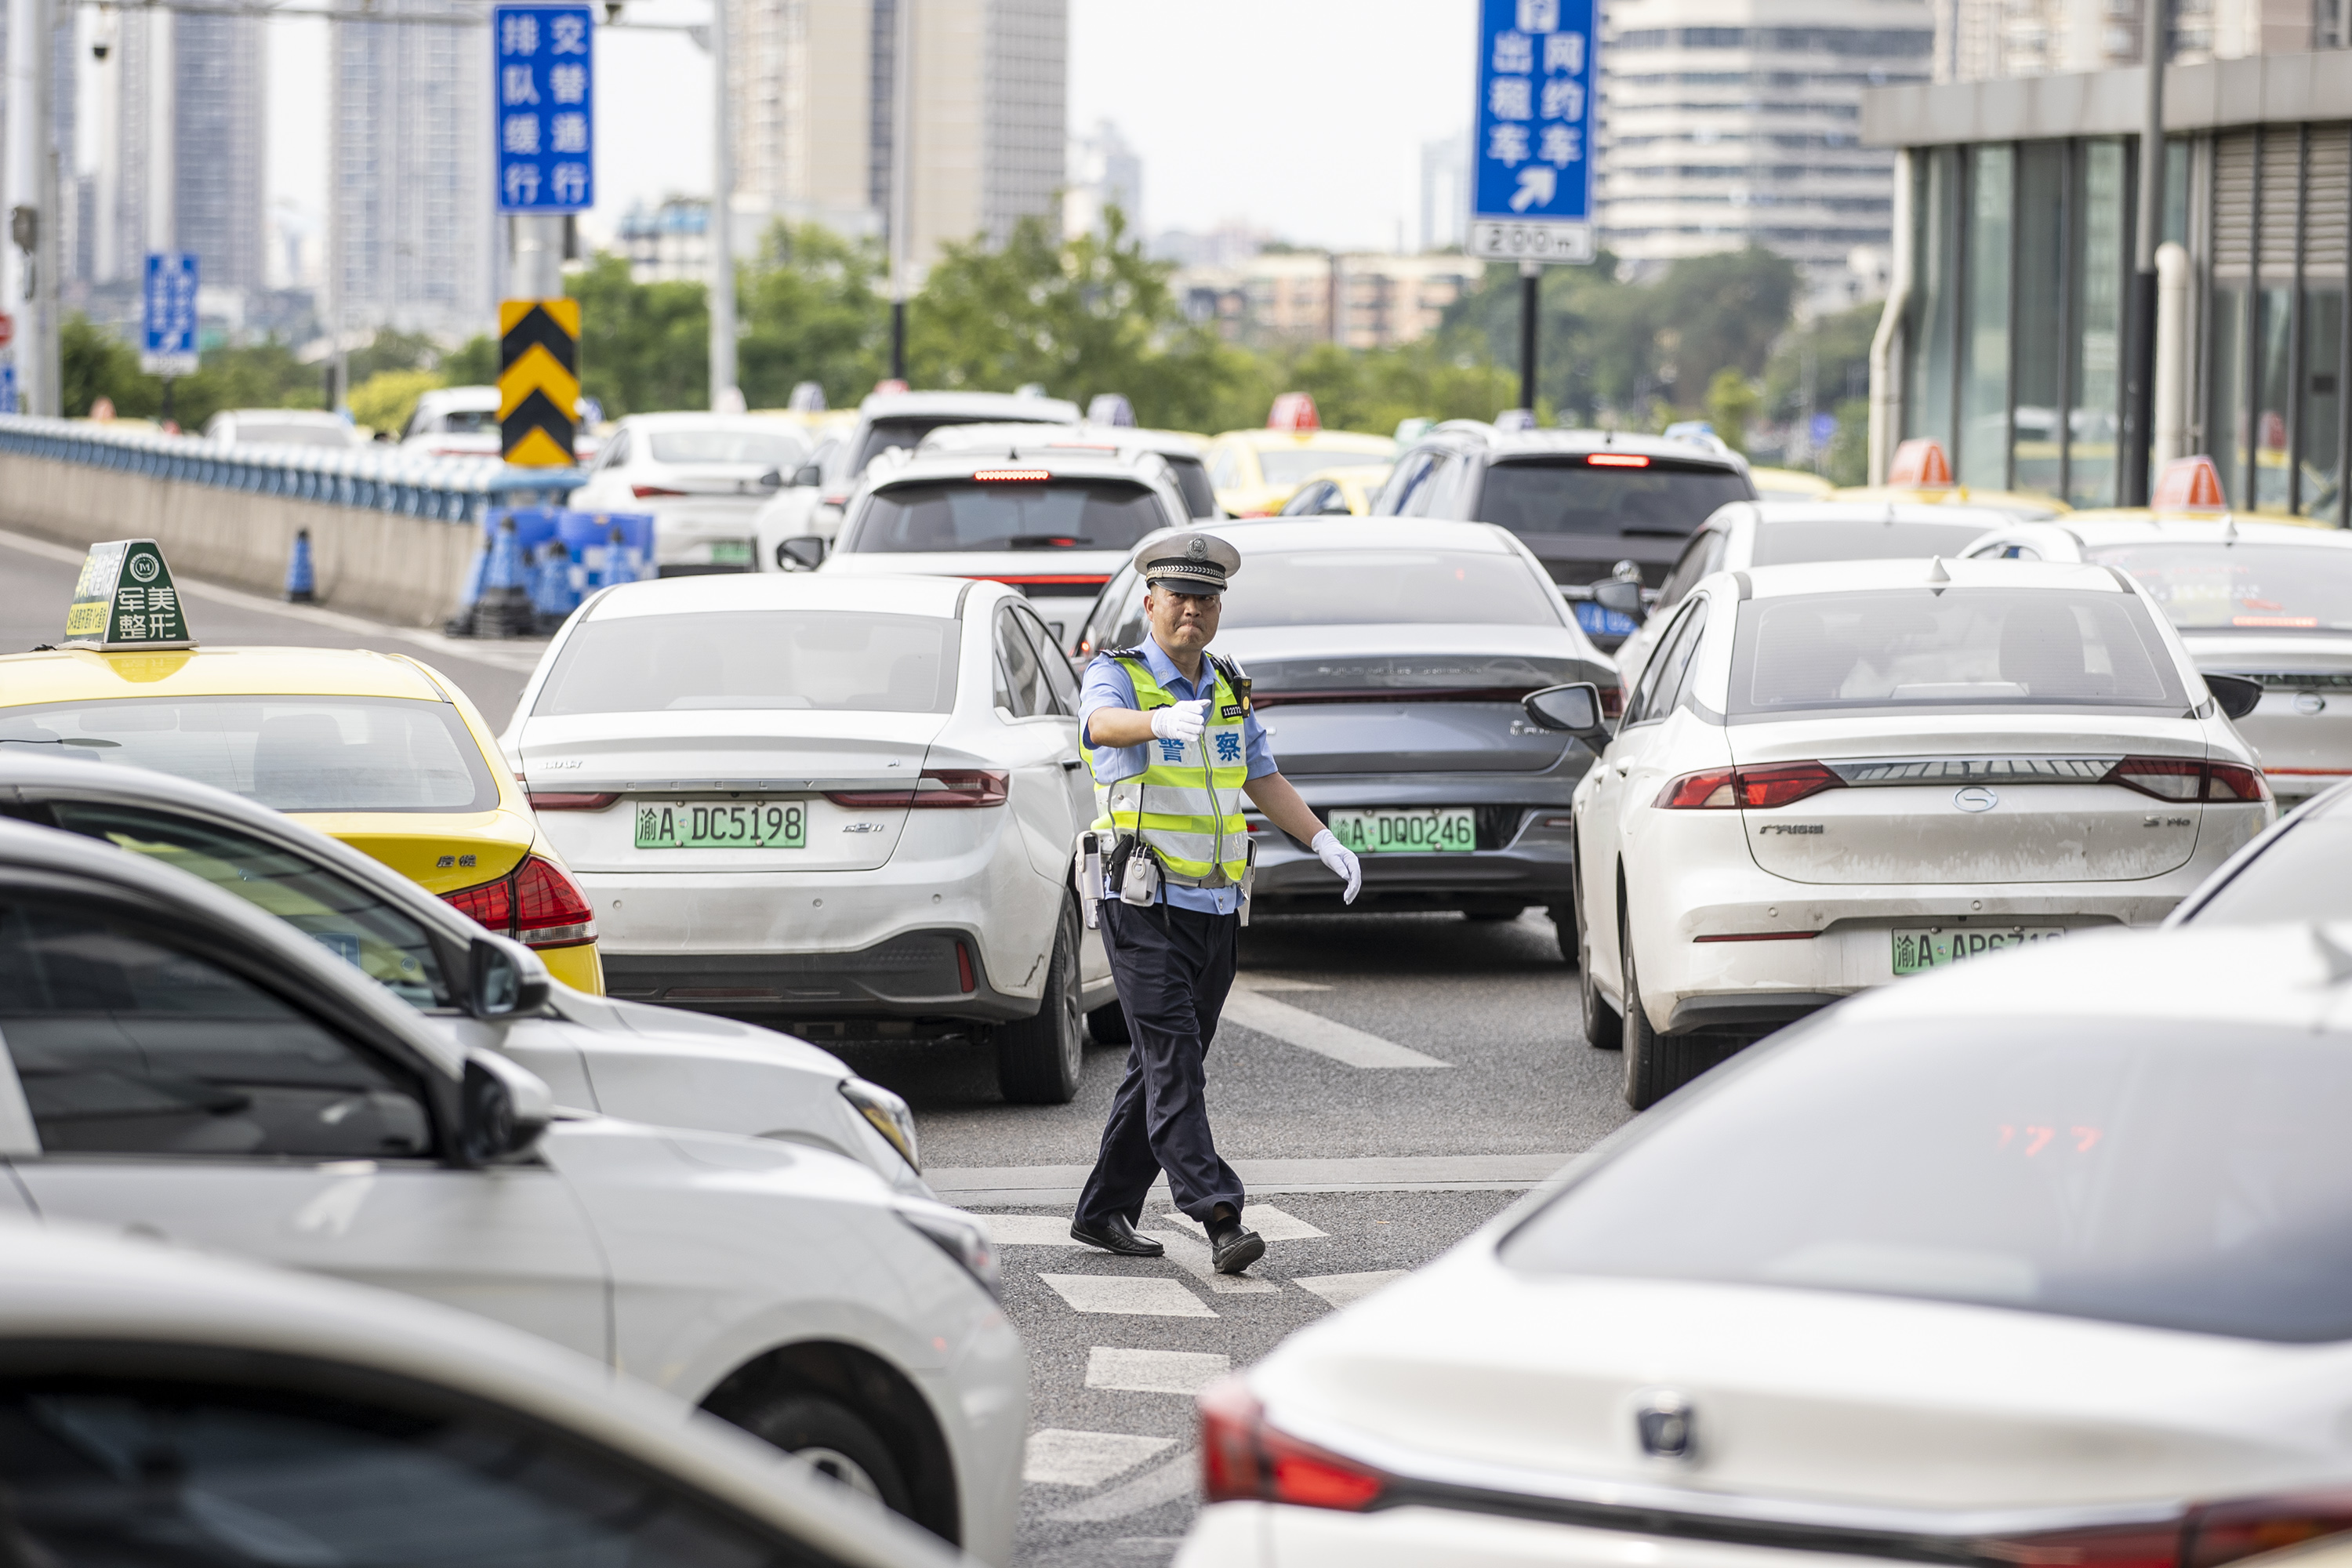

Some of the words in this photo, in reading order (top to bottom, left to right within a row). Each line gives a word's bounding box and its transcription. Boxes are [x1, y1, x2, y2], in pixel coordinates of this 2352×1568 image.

[501, 13, 542, 205] 排队缓行
[550, 13, 589, 205] 交替通行
[1487, 29, 1534, 169] 出租车
[1538, 30, 1585, 169] 网约车
[118, 586, 176, 612] 军美
[119, 613, 176, 640] 整形
